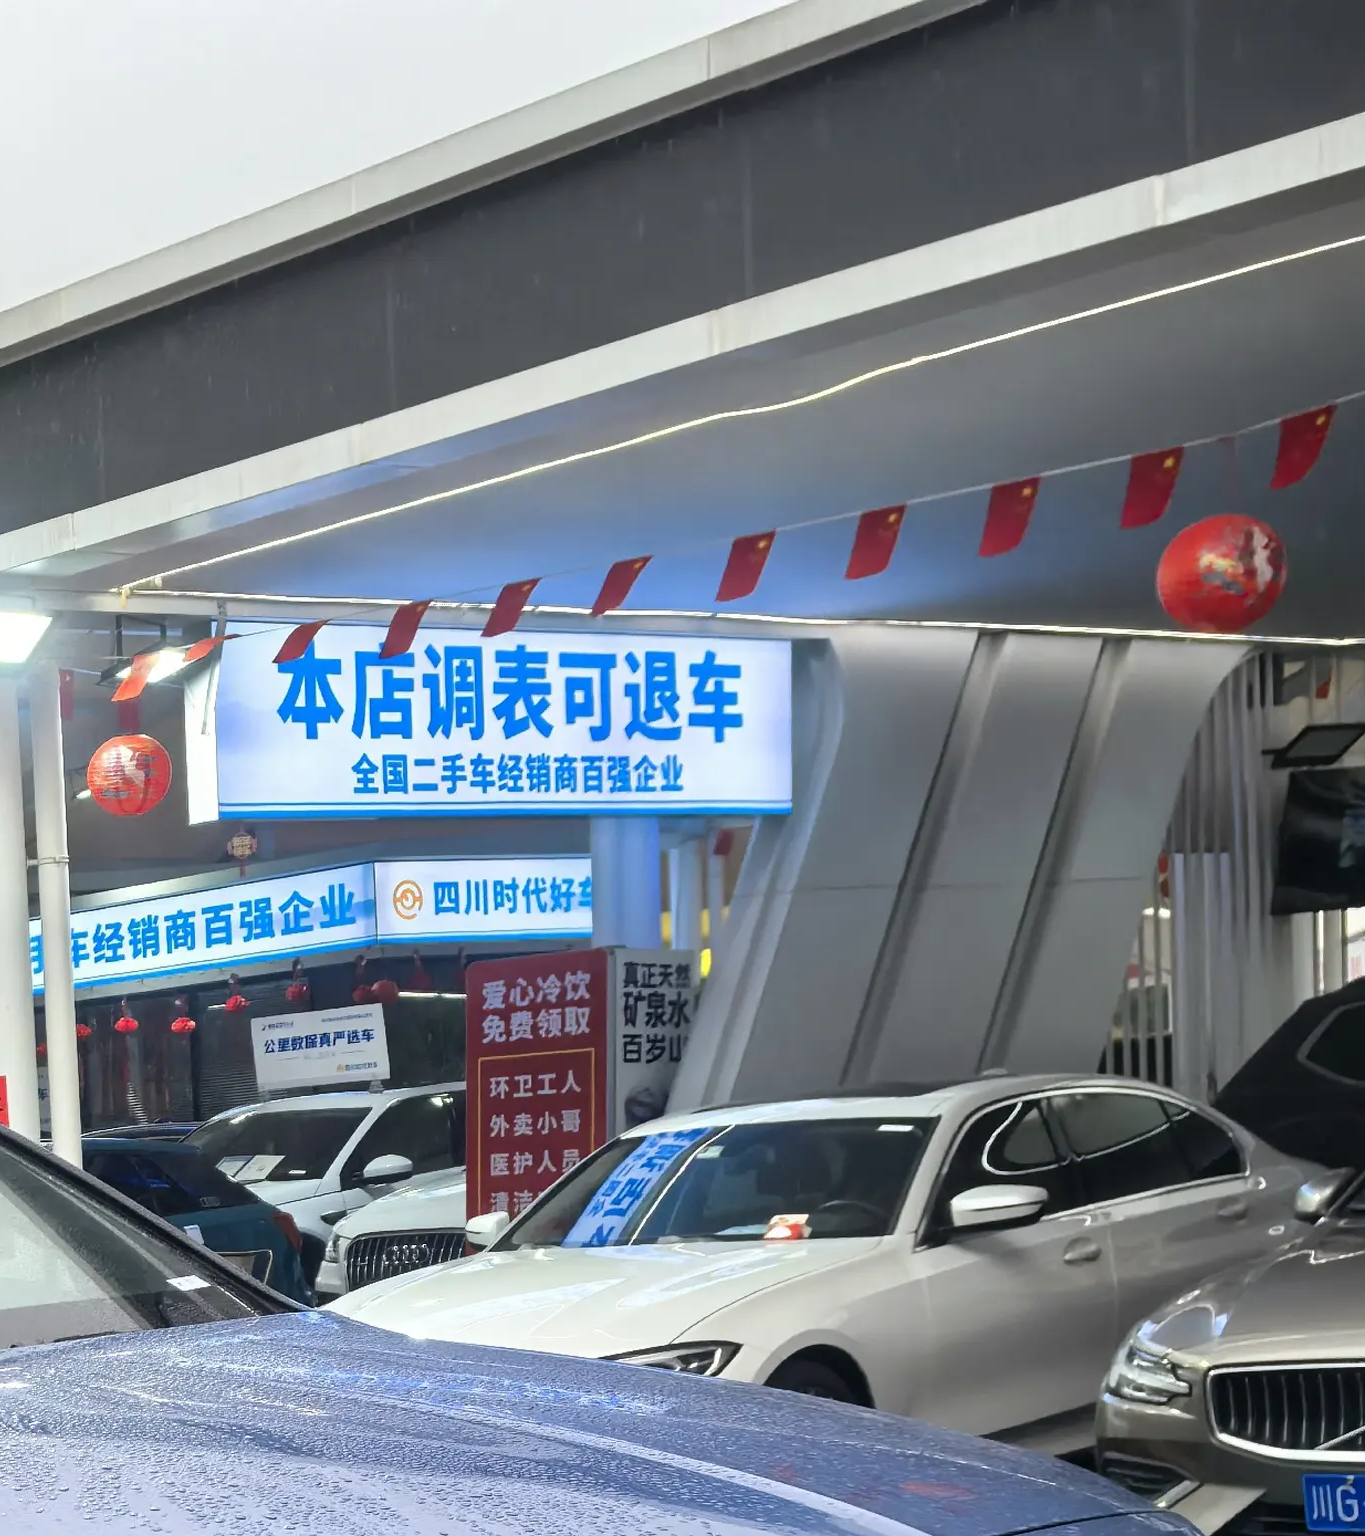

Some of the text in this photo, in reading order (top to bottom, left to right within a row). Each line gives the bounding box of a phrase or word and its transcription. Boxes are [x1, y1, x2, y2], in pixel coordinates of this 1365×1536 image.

[276, 643, 743, 743] 本店调表可退车
[352, 752, 683, 794] 全国二手车经销商百强企业
[482, 970, 591, 1010] 爱心冷饮
[623, 961, 691, 989] 真正天然
[482, 1006, 591, 1043] 免费领取
[623, 991, 691, 1028] 矿泉水
[489, 1070, 581, 1099] 环卫工人
[489, 1109, 581, 1137] 外卖小哥
[489, 1149, 581, 1176] 医护人员
